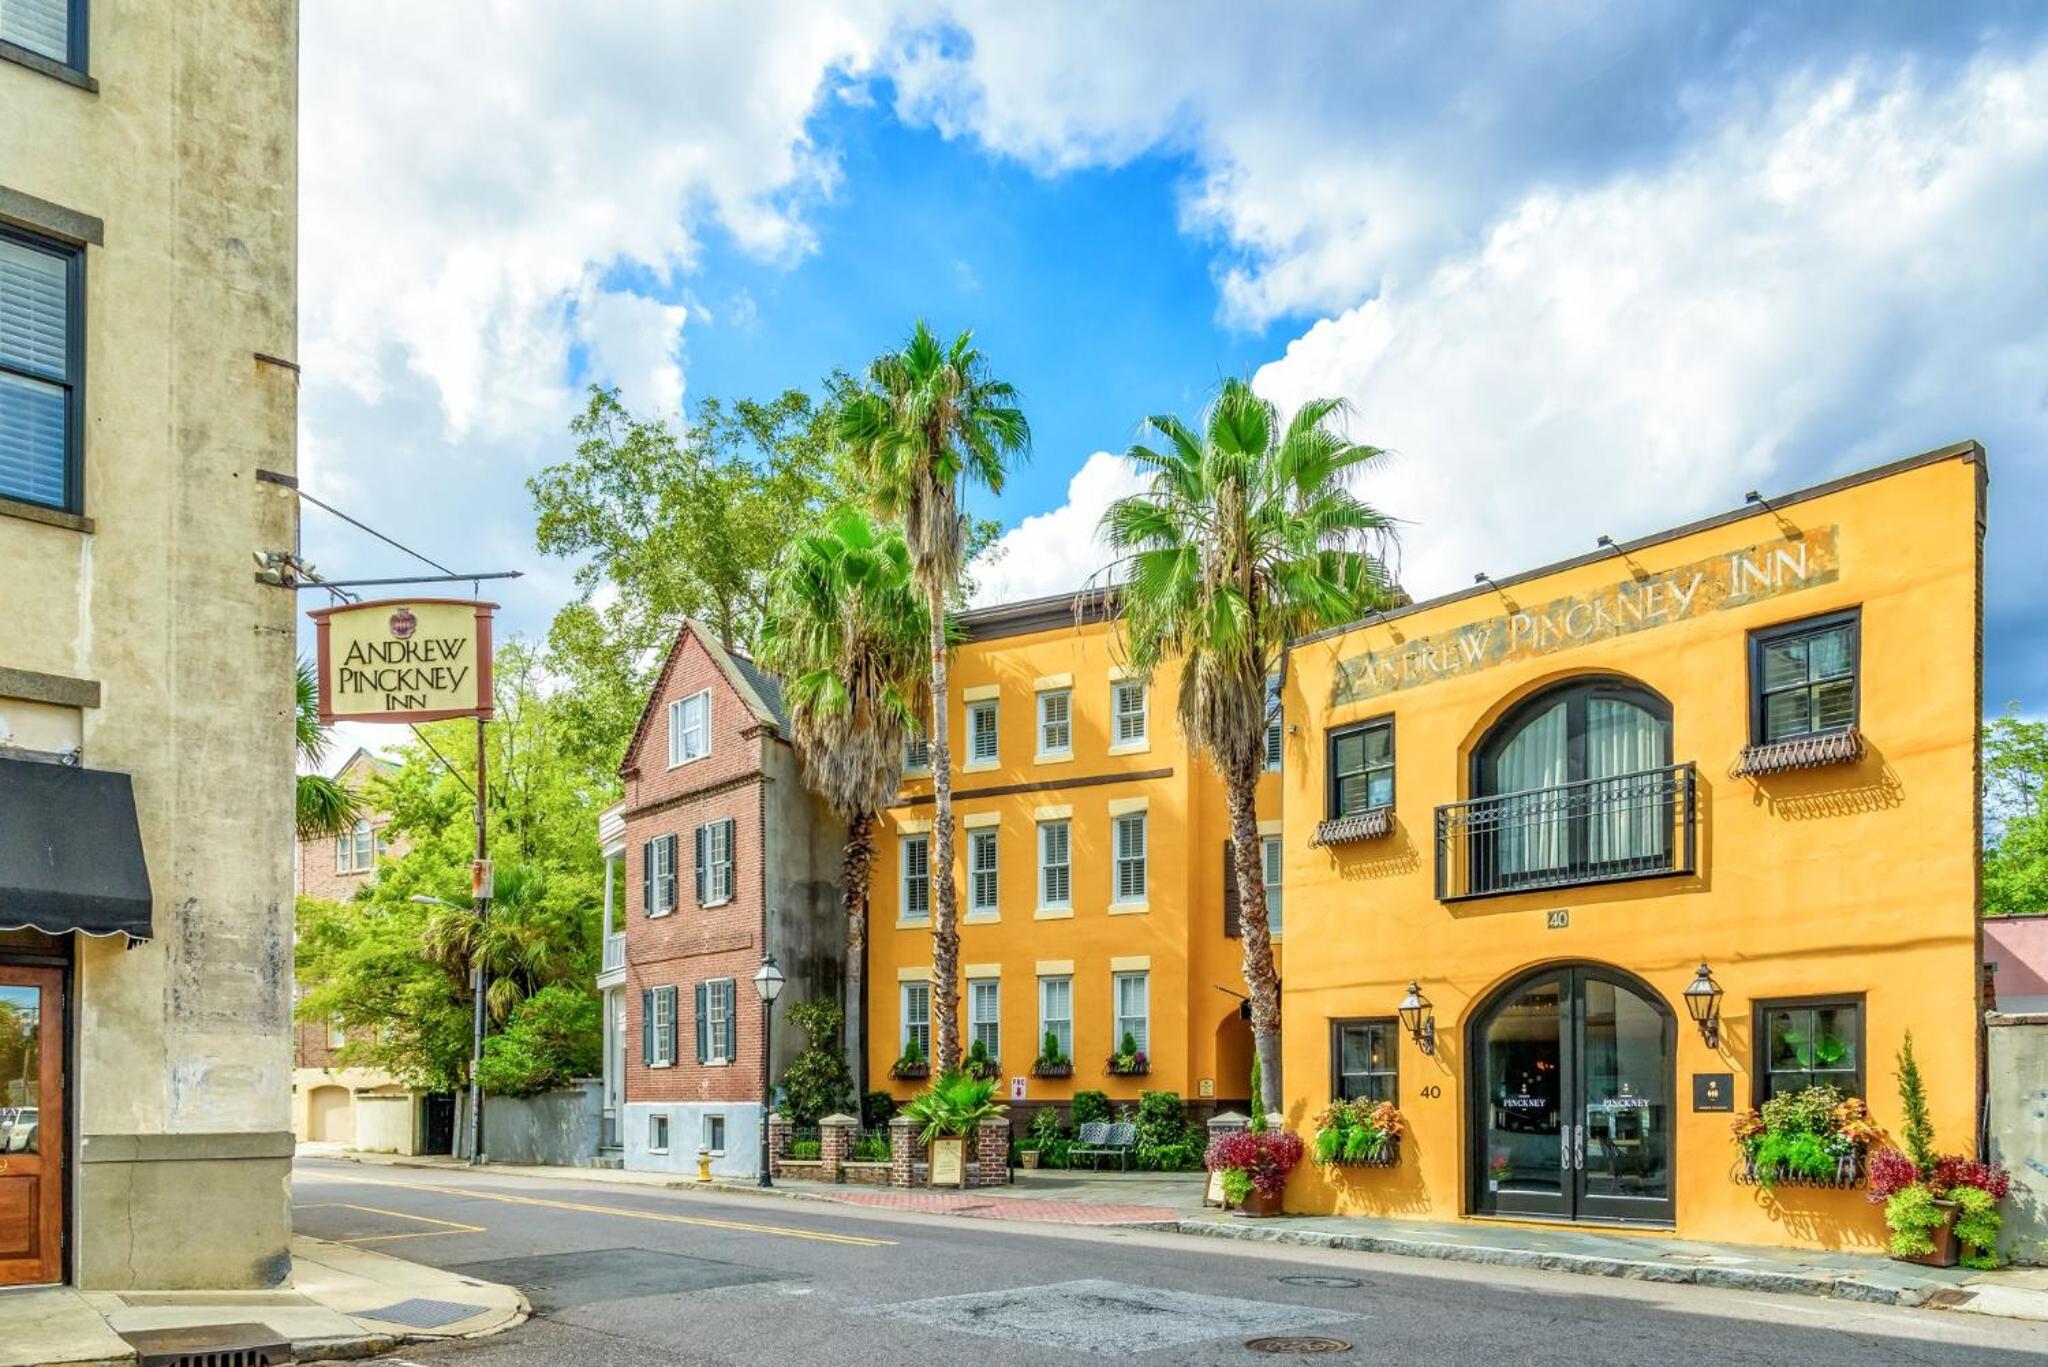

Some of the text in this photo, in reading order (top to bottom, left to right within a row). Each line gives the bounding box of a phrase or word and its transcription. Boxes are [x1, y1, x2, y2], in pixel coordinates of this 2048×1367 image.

[1352, 542, 1807, 693] ANDREW PINCKNEY INN
[344, 638, 467, 666] ANDREW
[339, 666, 468, 694] PINCKNEY
[386, 693, 427, 710] INN
[1550, 911, 1567, 927] 40
[1420, 1085, 1441, 1099] 40
[1503, 1098, 1546, 1107] PINCKNEY
[1603, 1098, 1650, 1107] PINCKNEY
